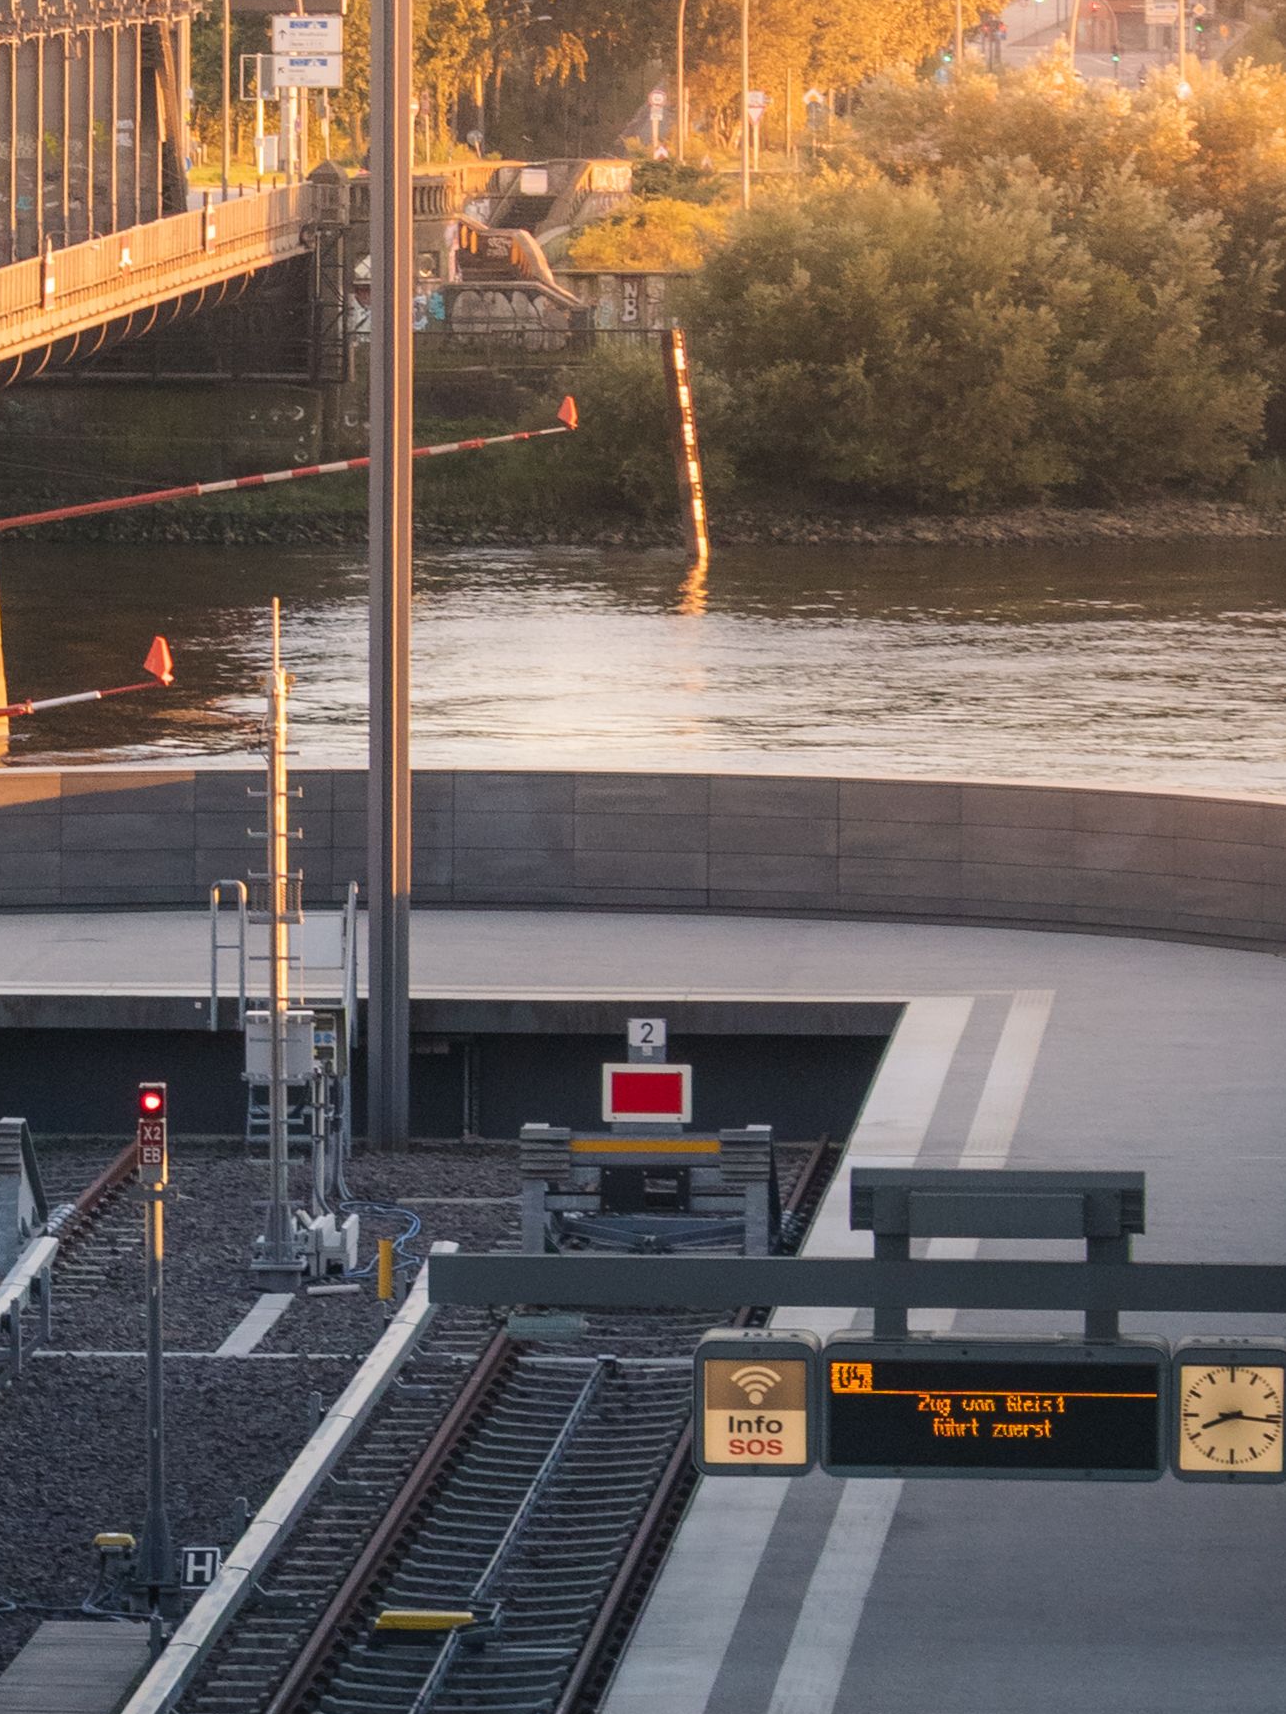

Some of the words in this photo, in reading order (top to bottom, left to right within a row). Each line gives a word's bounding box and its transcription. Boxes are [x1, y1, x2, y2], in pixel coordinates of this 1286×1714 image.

[640, 1023, 655, 1045] 2
[142, 1124, 162, 1141] X2
[142, 1147, 162, 1164] EB
[917, 1394, 952, 1417] Zug
[962, 1398, 996, 1412] von
[1005, 1395, 1053, 1413] Gleis
[1055, 1395, 1066, 1414] 1
[728, 1415, 784, 1434] Info
[991, 1419, 1053, 1438] zuerst
[729, 1438, 784, 1456] SOS
[186, 1552, 213, 1583] H
